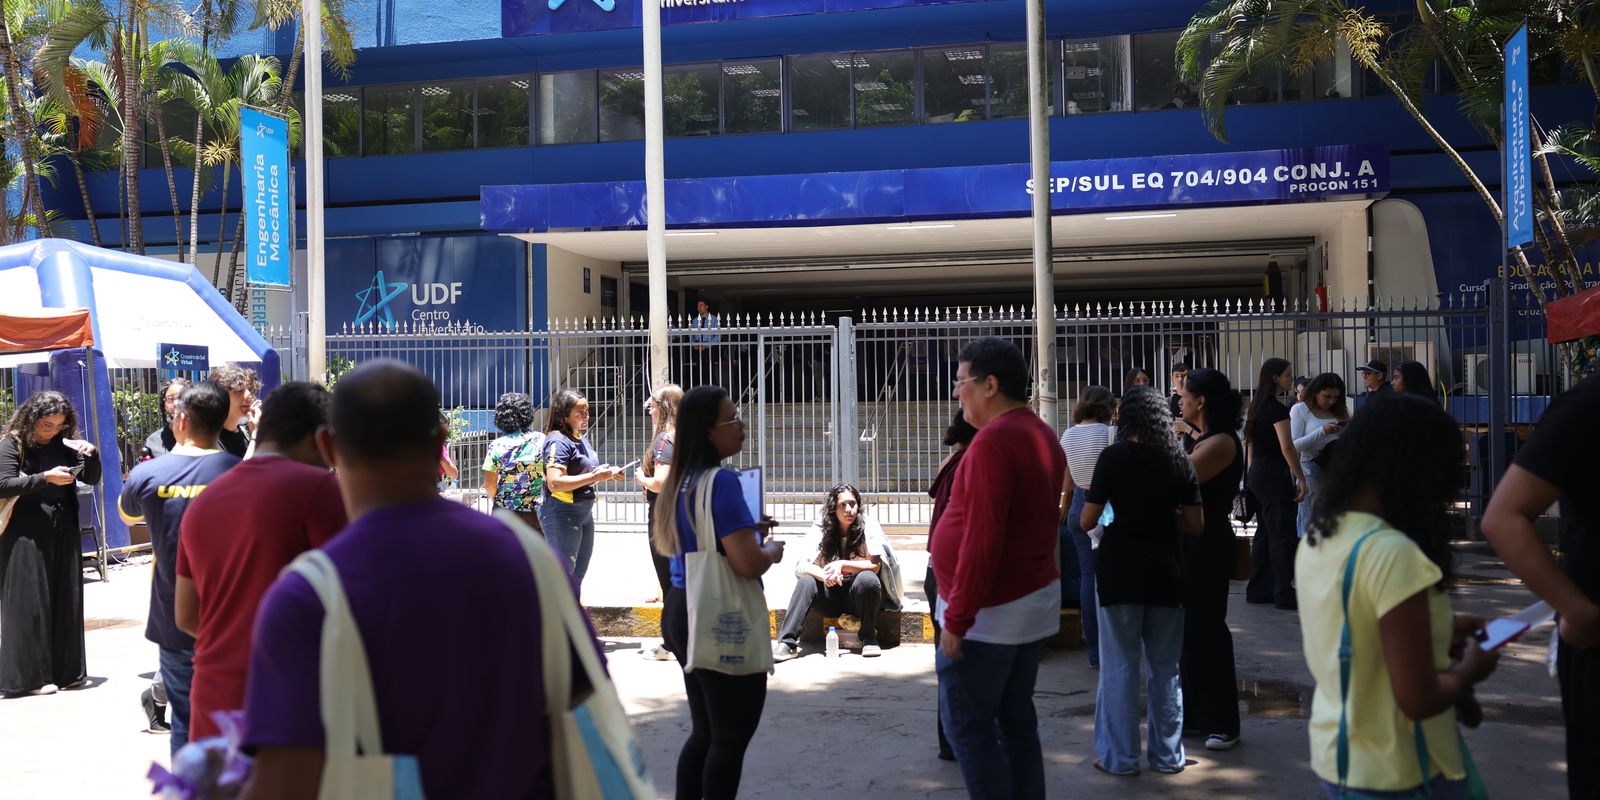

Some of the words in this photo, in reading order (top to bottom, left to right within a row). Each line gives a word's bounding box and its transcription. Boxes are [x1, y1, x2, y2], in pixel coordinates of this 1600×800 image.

[1132, 172, 1164, 189] EQ
[1171, 168, 1268, 187] 704/904
[1273, 161, 1351, 182] CONJ.
[1357, 159, 1375, 177] A
[1511, 101, 1520, 231] Arquitetura
[1290, 181, 1348, 193] PROCON
[254, 153, 269, 267] Engenharia
[269, 164, 280, 261] Mecânica
[411, 282, 462, 305] UDF
[411, 309, 450, 320] Centro
